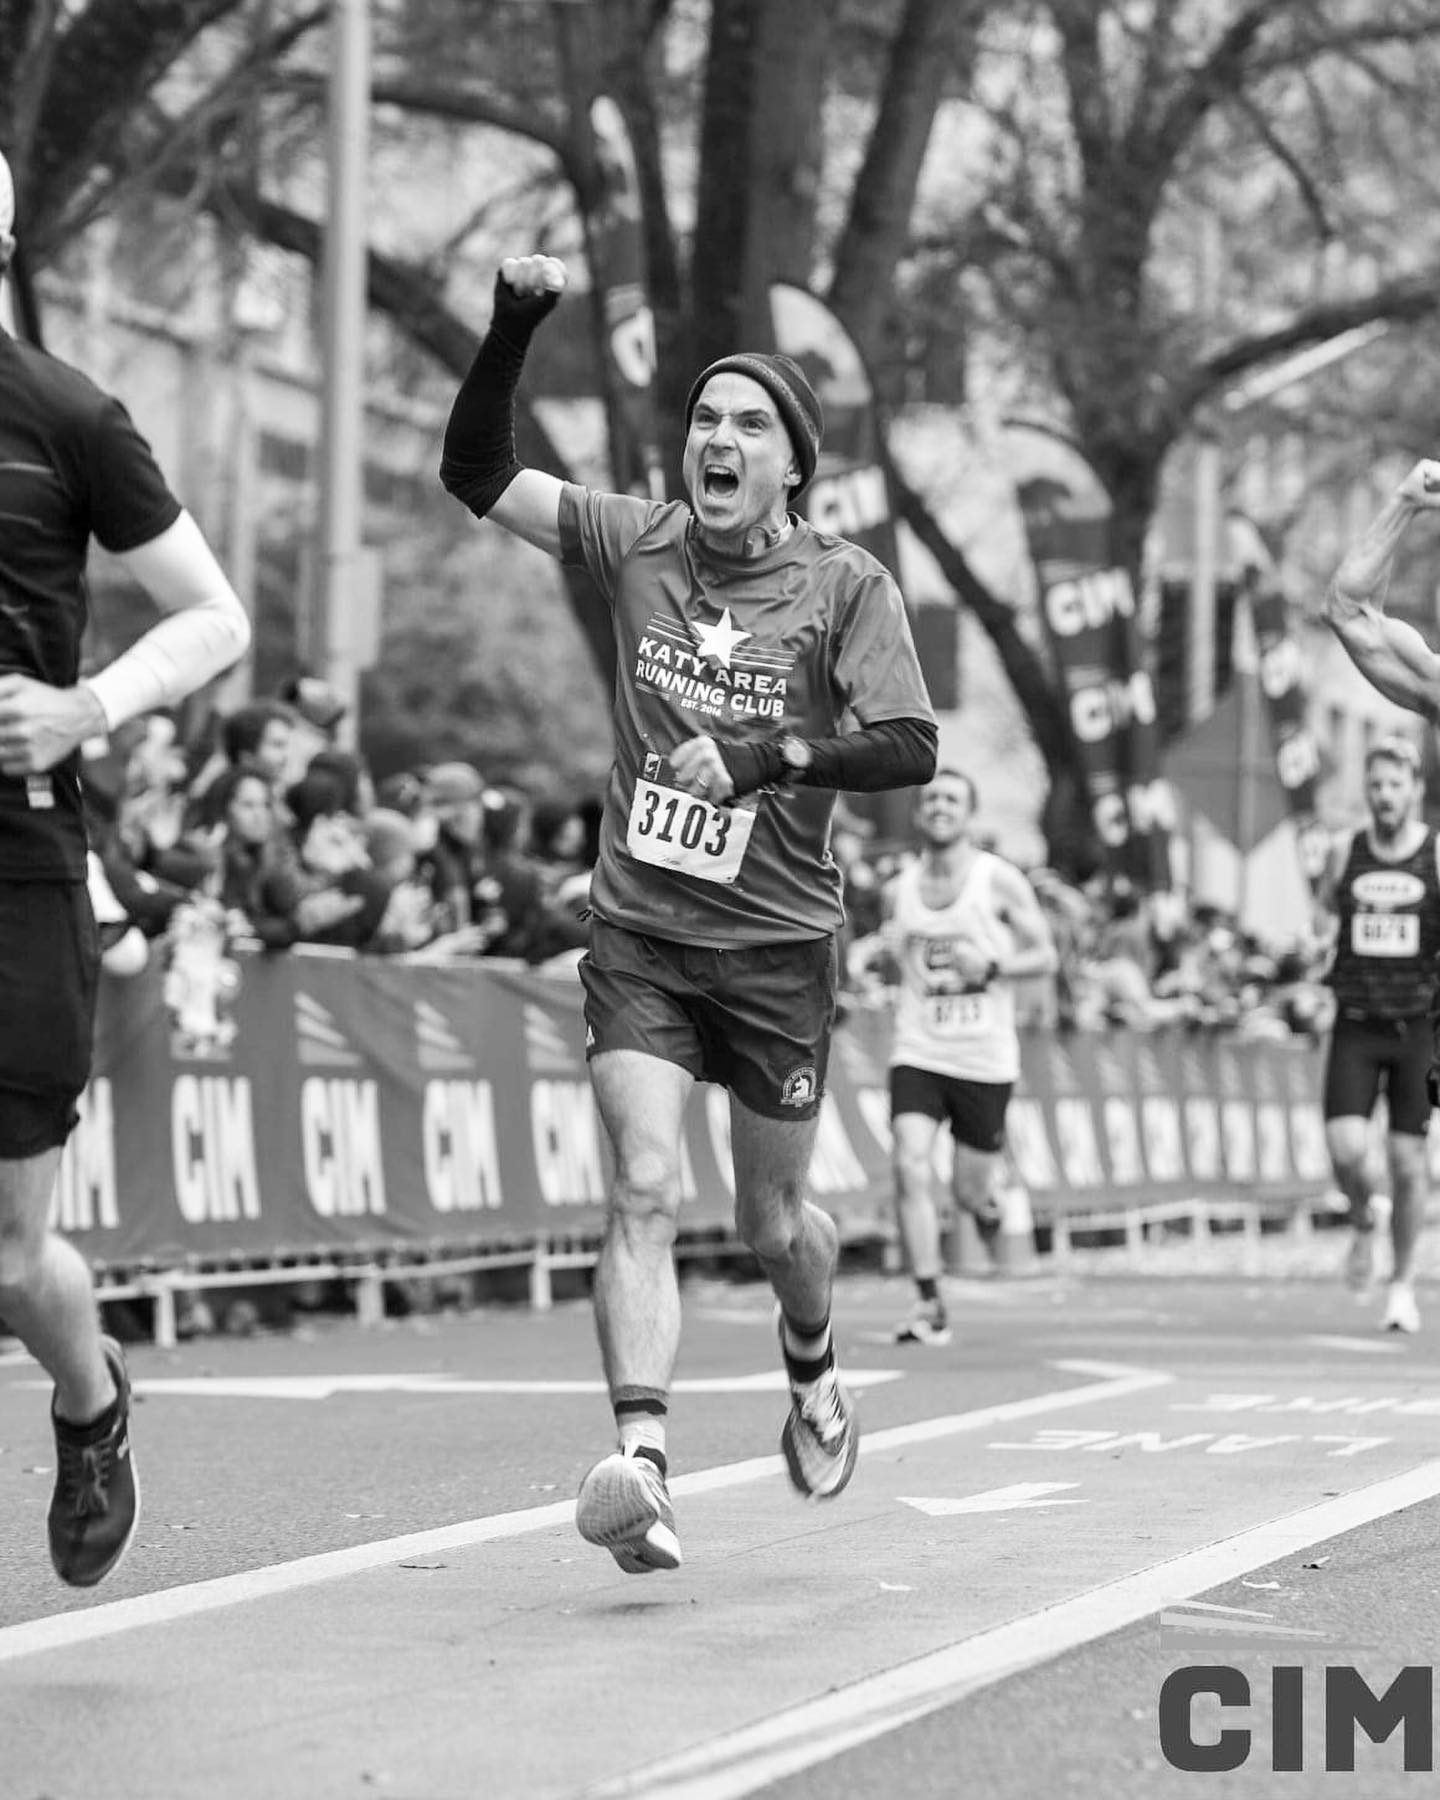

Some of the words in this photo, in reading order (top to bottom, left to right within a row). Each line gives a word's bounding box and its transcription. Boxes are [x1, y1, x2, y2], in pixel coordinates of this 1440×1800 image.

[807, 464, 889, 535] CIM
[1046, 567, 1135, 635] CIM
[636, 659, 726, 705] RUNNING
[731, 693, 785, 717] CLUB
[637, 636, 707, 676] KATY
[715, 669, 787, 695] AREA
[637, 790, 732, 856] 3103
[46, 1075, 120, 1231] IM
[171, 1075, 261, 1222] CIM
[301, 1077, 387, 1216] CIM
[423, 1079, 502, 1212] CIM
[529, 1079, 605, 1206] CIM
[987, 1429, 1395, 1457] LANE
